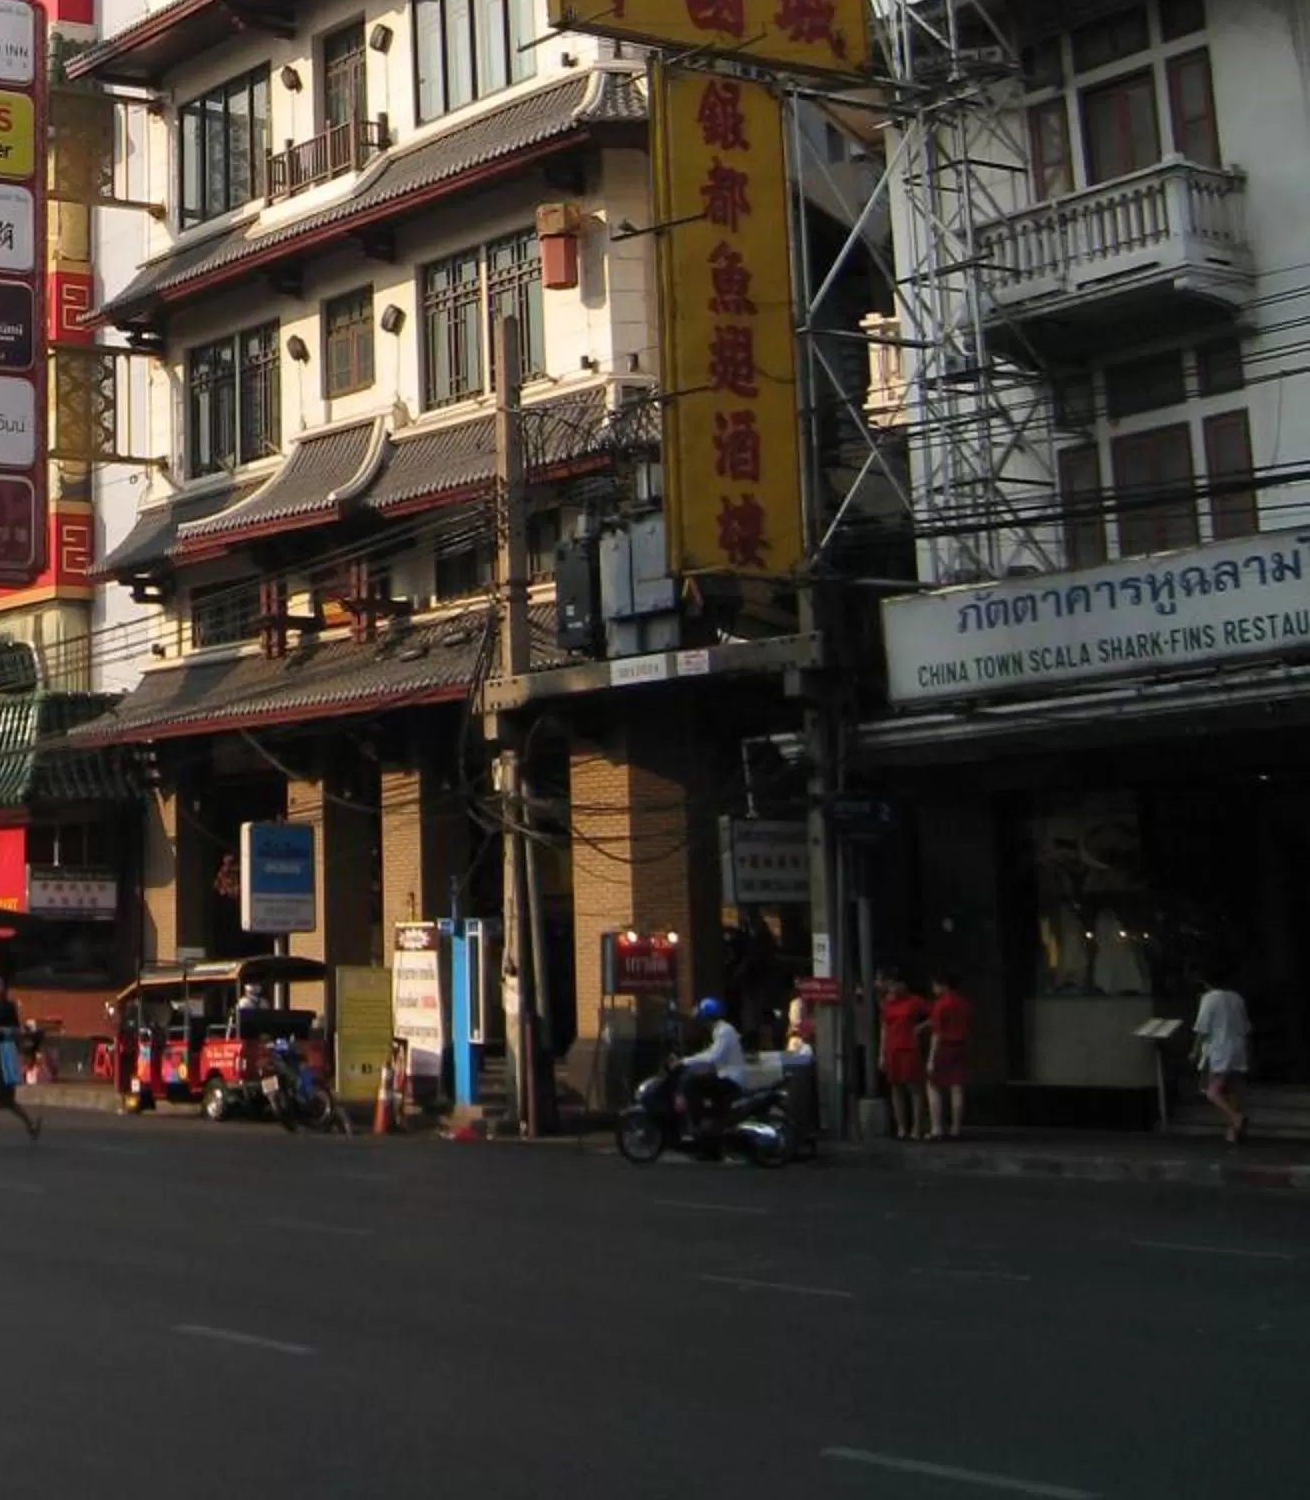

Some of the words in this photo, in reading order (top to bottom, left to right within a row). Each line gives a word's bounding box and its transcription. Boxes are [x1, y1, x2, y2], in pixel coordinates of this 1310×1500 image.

[5, 42, 30, 59] INN
[917, 659, 970, 688] CHINA
[974, 650, 1024, 681] TOWN
[1028, 641, 1093, 674] SCALA
